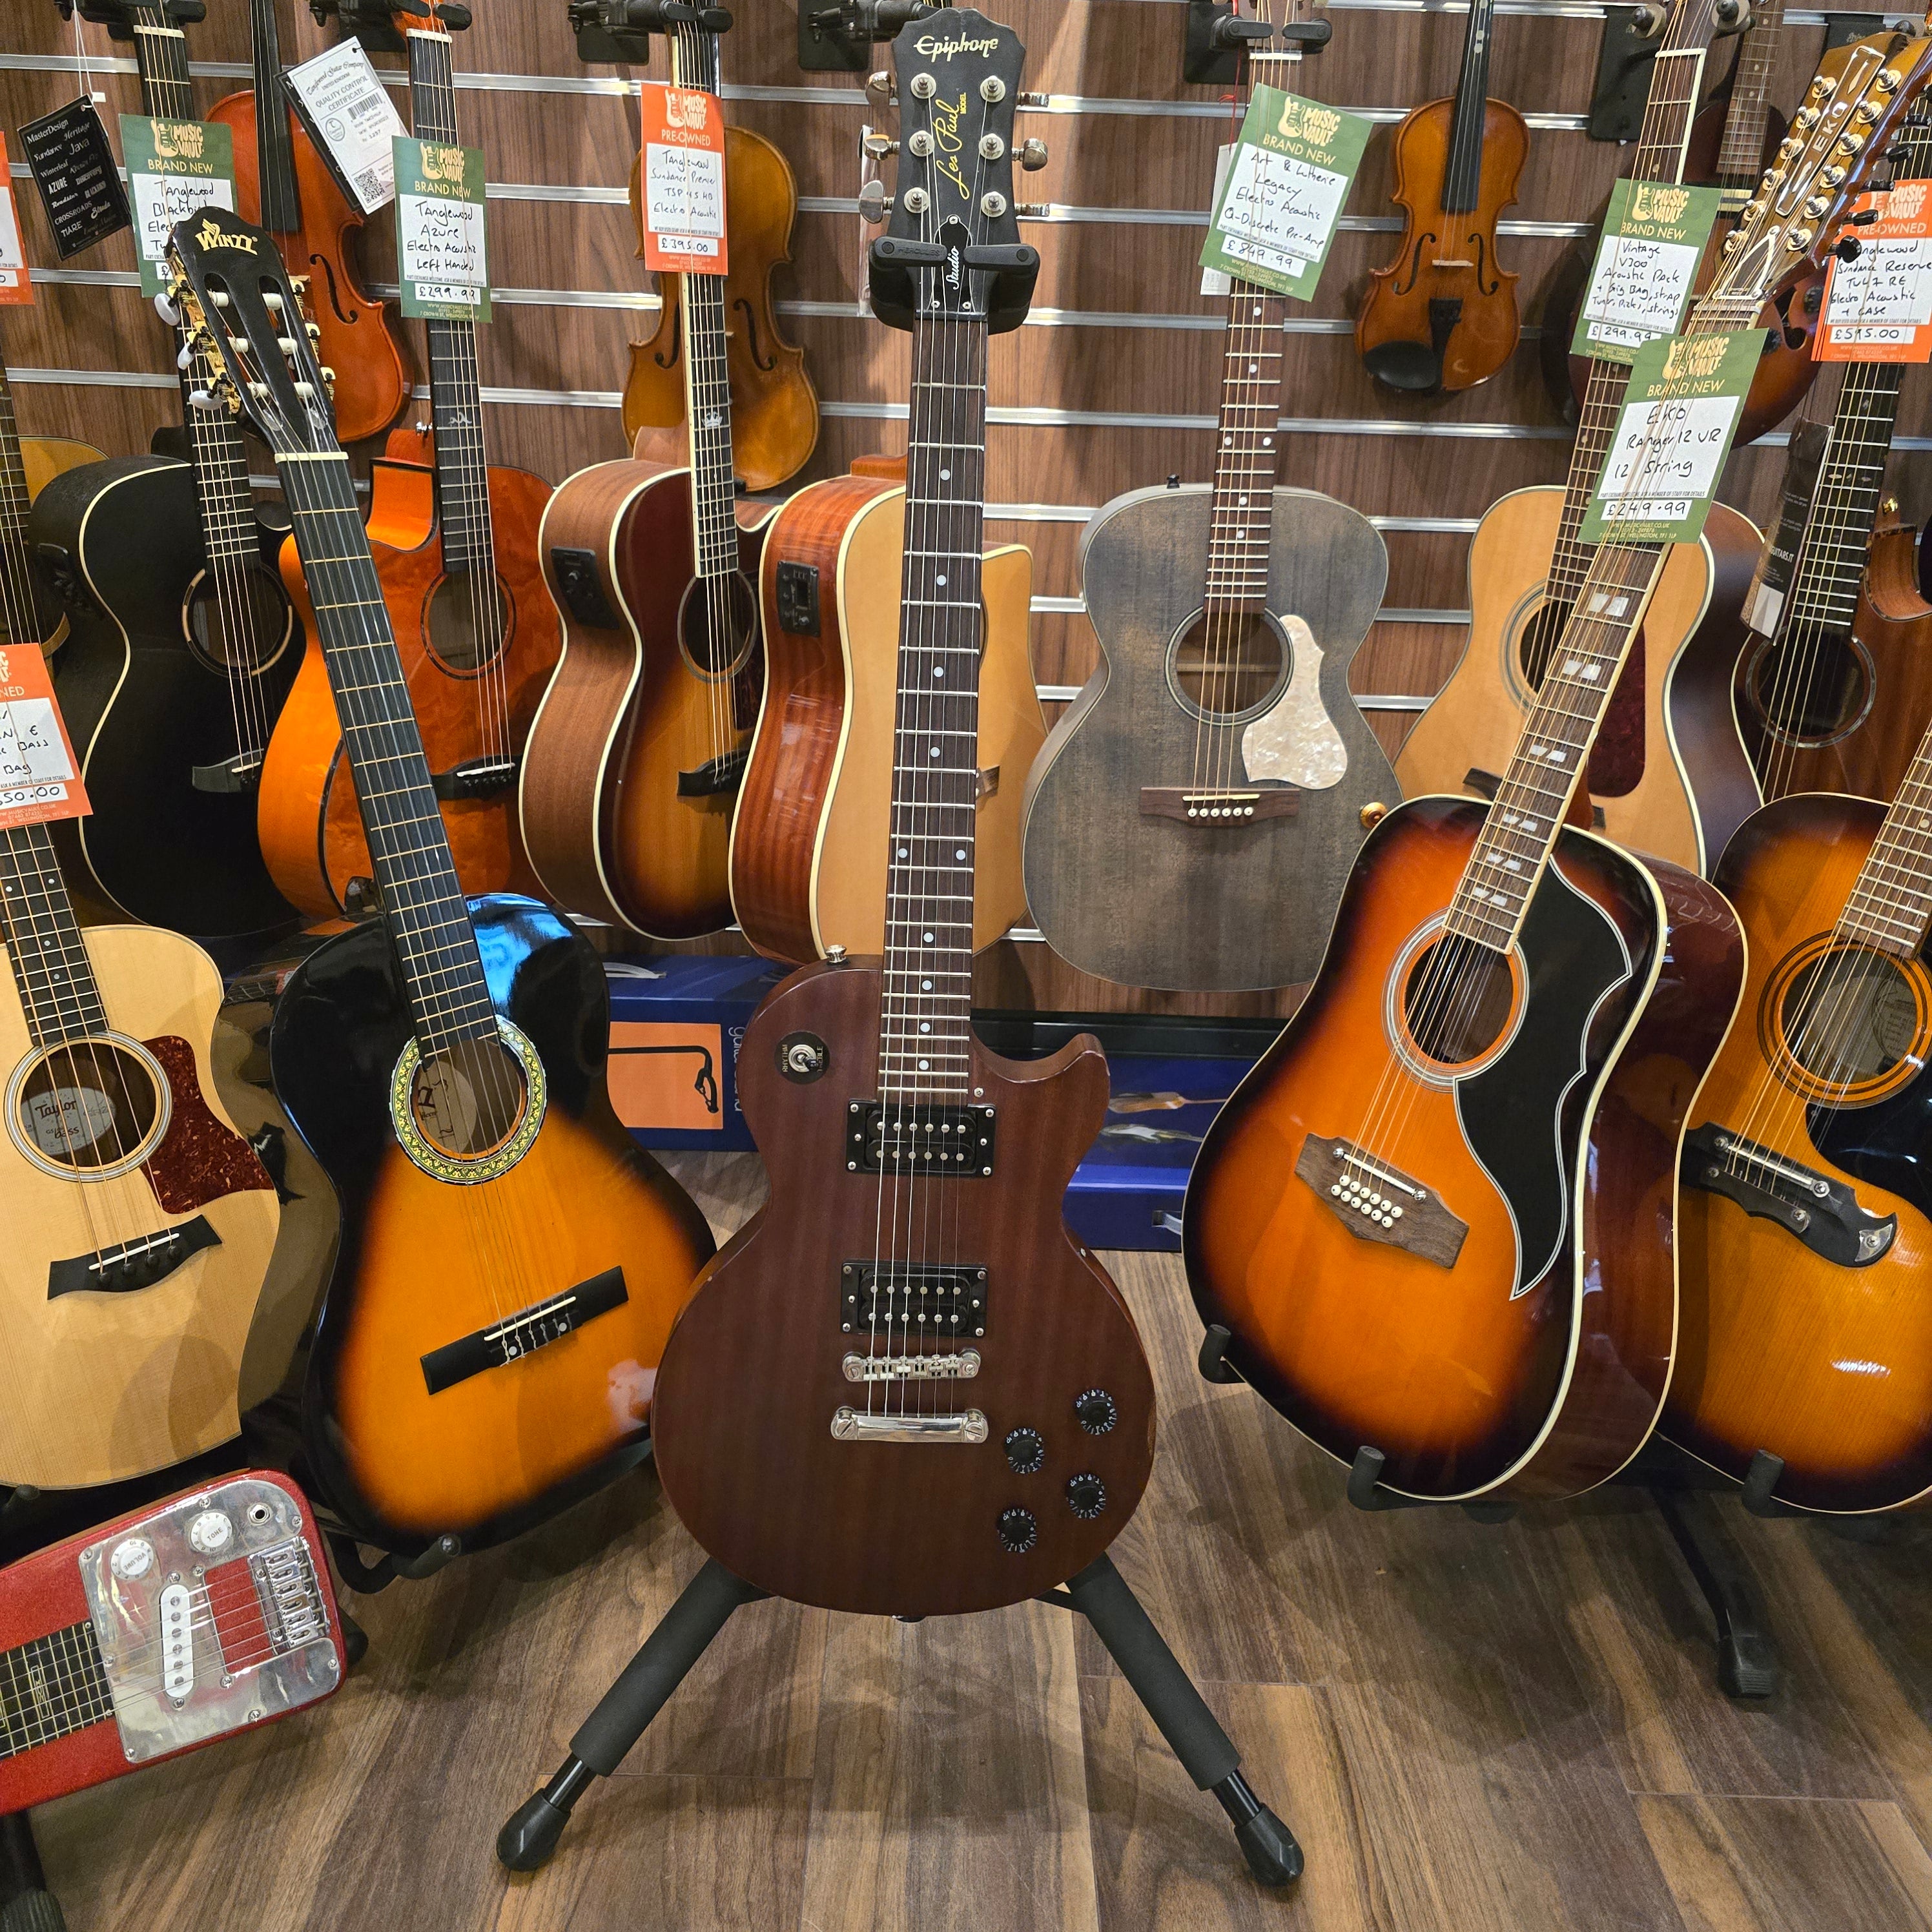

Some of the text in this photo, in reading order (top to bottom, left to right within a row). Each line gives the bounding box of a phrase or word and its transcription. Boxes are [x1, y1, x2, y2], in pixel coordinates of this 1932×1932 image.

[913, 32, 998, 62] Epiphone
[334, 72, 350, 83] KINGDOM
[315, 76, 369, 108] QUALITY CONTROL
[329, 87, 365, 111] CERTIFICATE
[683, 94, 706, 114] MUSIC
[685, 112, 706, 130] VAULT
[1304, 107, 1341, 132] MUSIC
[1813, 102, 1847, 152] EKO
[27, 118, 68, 145] MasterDesign
[64, 122, 90, 141] Heritage
[173, 123, 203, 142] MUSIC
[661, 129, 710, 146] PRE-OWNED
[1302, 123, 1333, 147] VAULT
[69, 138, 90, 155] Java
[177, 140, 203, 158] VAULT
[932, 99, 969, 200] Les Paul
[1263, 134, 1336, 166] BRAND NEW
[148, 159, 213, 174] BRAND NEW
[439, 148, 465, 167] MUSIC
[1251, 152, 1273, 165] Art
[40, 159, 68, 178] Winterleaf
[48, 177, 68, 194] AZURE
[415, 181, 471, 198] BRAND NEW
[1889, 183, 1927, 203] MUSIC
[1653, 188, 1690, 208] MUSIC
[54, 201, 92, 225] CROSSROADS
[1653, 205, 1683, 223] VAULT
[1889, 200, 1922, 220] VAULT
[421, 224, 459, 239] Azure
[1621, 221, 1687, 241] BRAND NEW
[1857, 222, 1927, 236] PRE-OWNED
[662, 238, 708, 252] £395.00
[946, 245, 960, 290] Studio
[1647, 379, 1725, 397] BRAND NEW
[1615, 464, 1629, 479] 12
[1607, 502, 1685, 516] £249.99
[35, 1100, 77, 1119] Taylor
[207, 1526, 223, 1541] TONE
[124, 1552, 146, 1571] VOLUME
